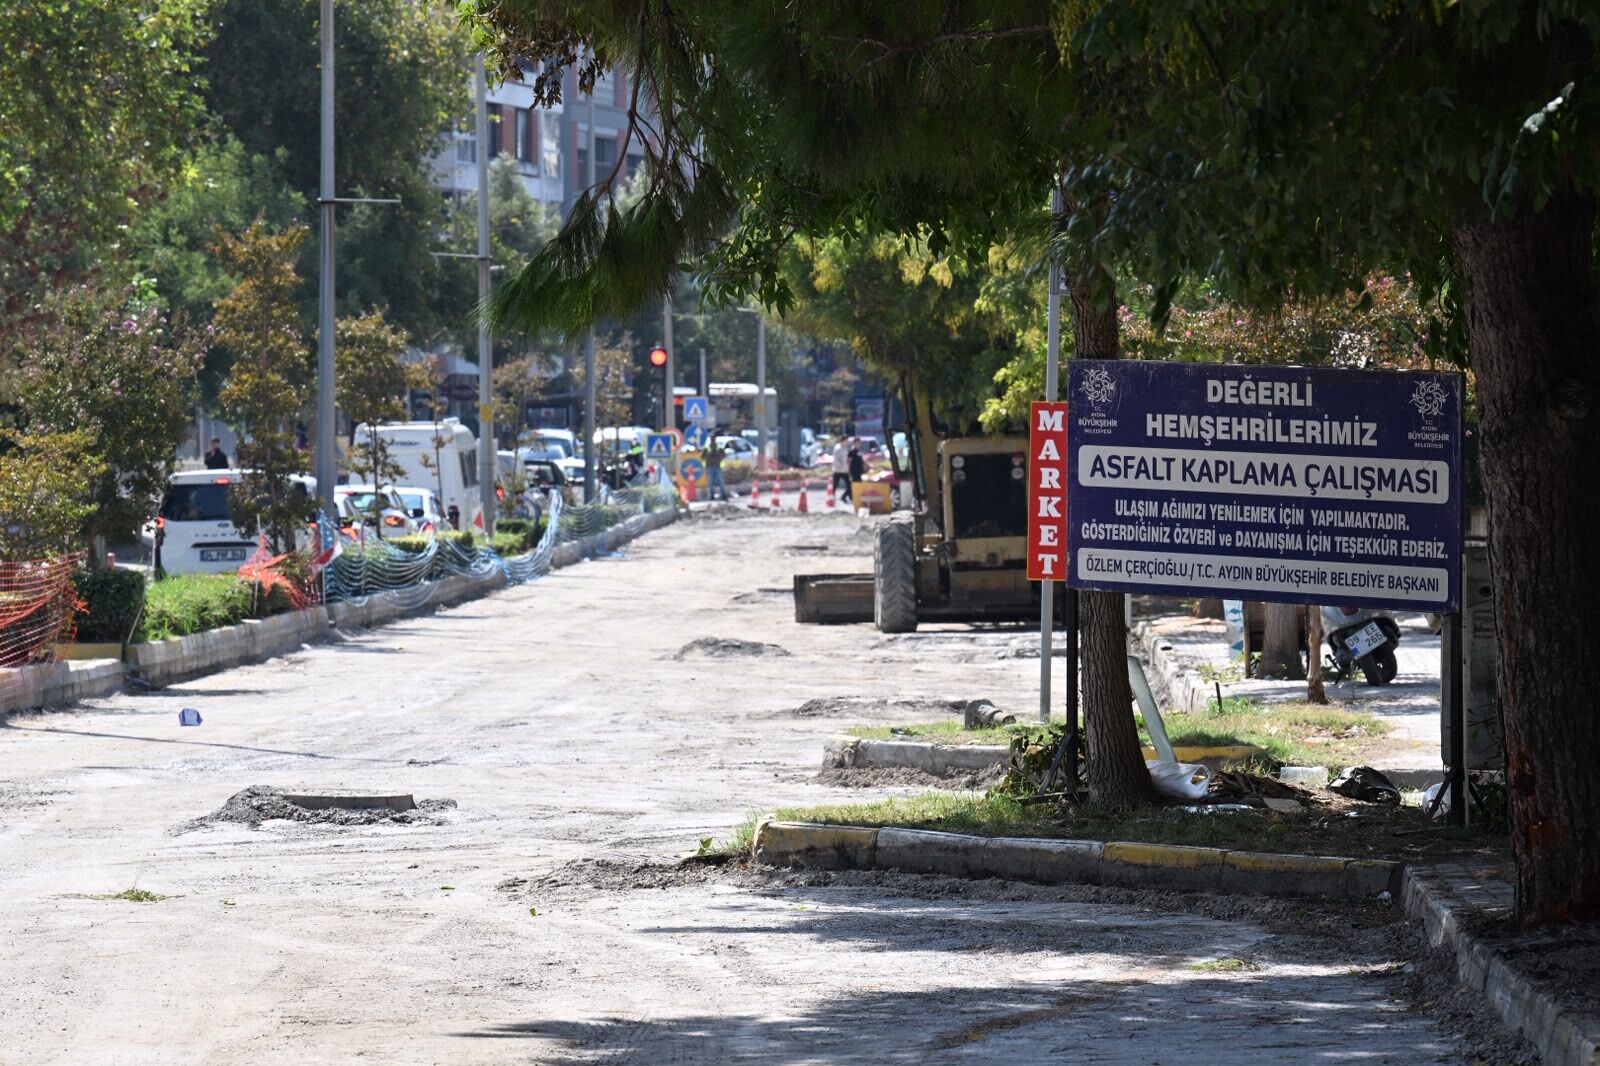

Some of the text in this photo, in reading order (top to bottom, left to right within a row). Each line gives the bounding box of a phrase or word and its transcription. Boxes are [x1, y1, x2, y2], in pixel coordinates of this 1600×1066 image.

[1206, 374, 1313, 406] DEĞERLİ
[1078, 417, 1118, 428] BÜYÜKŞEHİR
[1146, 411, 1378, 446] HEMŞEHRİLERİMİZ
[1408, 430, 1450, 442] BÜYÜKŞEHİR
[1037, 410, 1064, 575] MARKET
[1089, 454, 1438, 498] ASFALT KAPLAMA ÇALIŞMASI
[1115, 497, 1410, 531] ULAŞIM AĞIMIZI YENİLEMEK İÇİN YAPILMAKTADIR.
[1081, 518, 1448, 559] GÖSTERDİĞİNİZ ÖZVERİ ve DAYANIŞMA İÇİN TEŞEKKÜR EDERİZ.
[1086, 555, 1122, 573] ÖZLEM
[1218, 565, 1252, 581] AYDIN
[1255, 564, 1327, 588] BÜYÜKŞEHİR
[1330, 570, 1385, 589] BELEDİYE
[1387, 575, 1439, 594] BAŞKANI
[1347, 623, 1377, 647] 09 EE
[1365, 632, 1383, 647] 265
